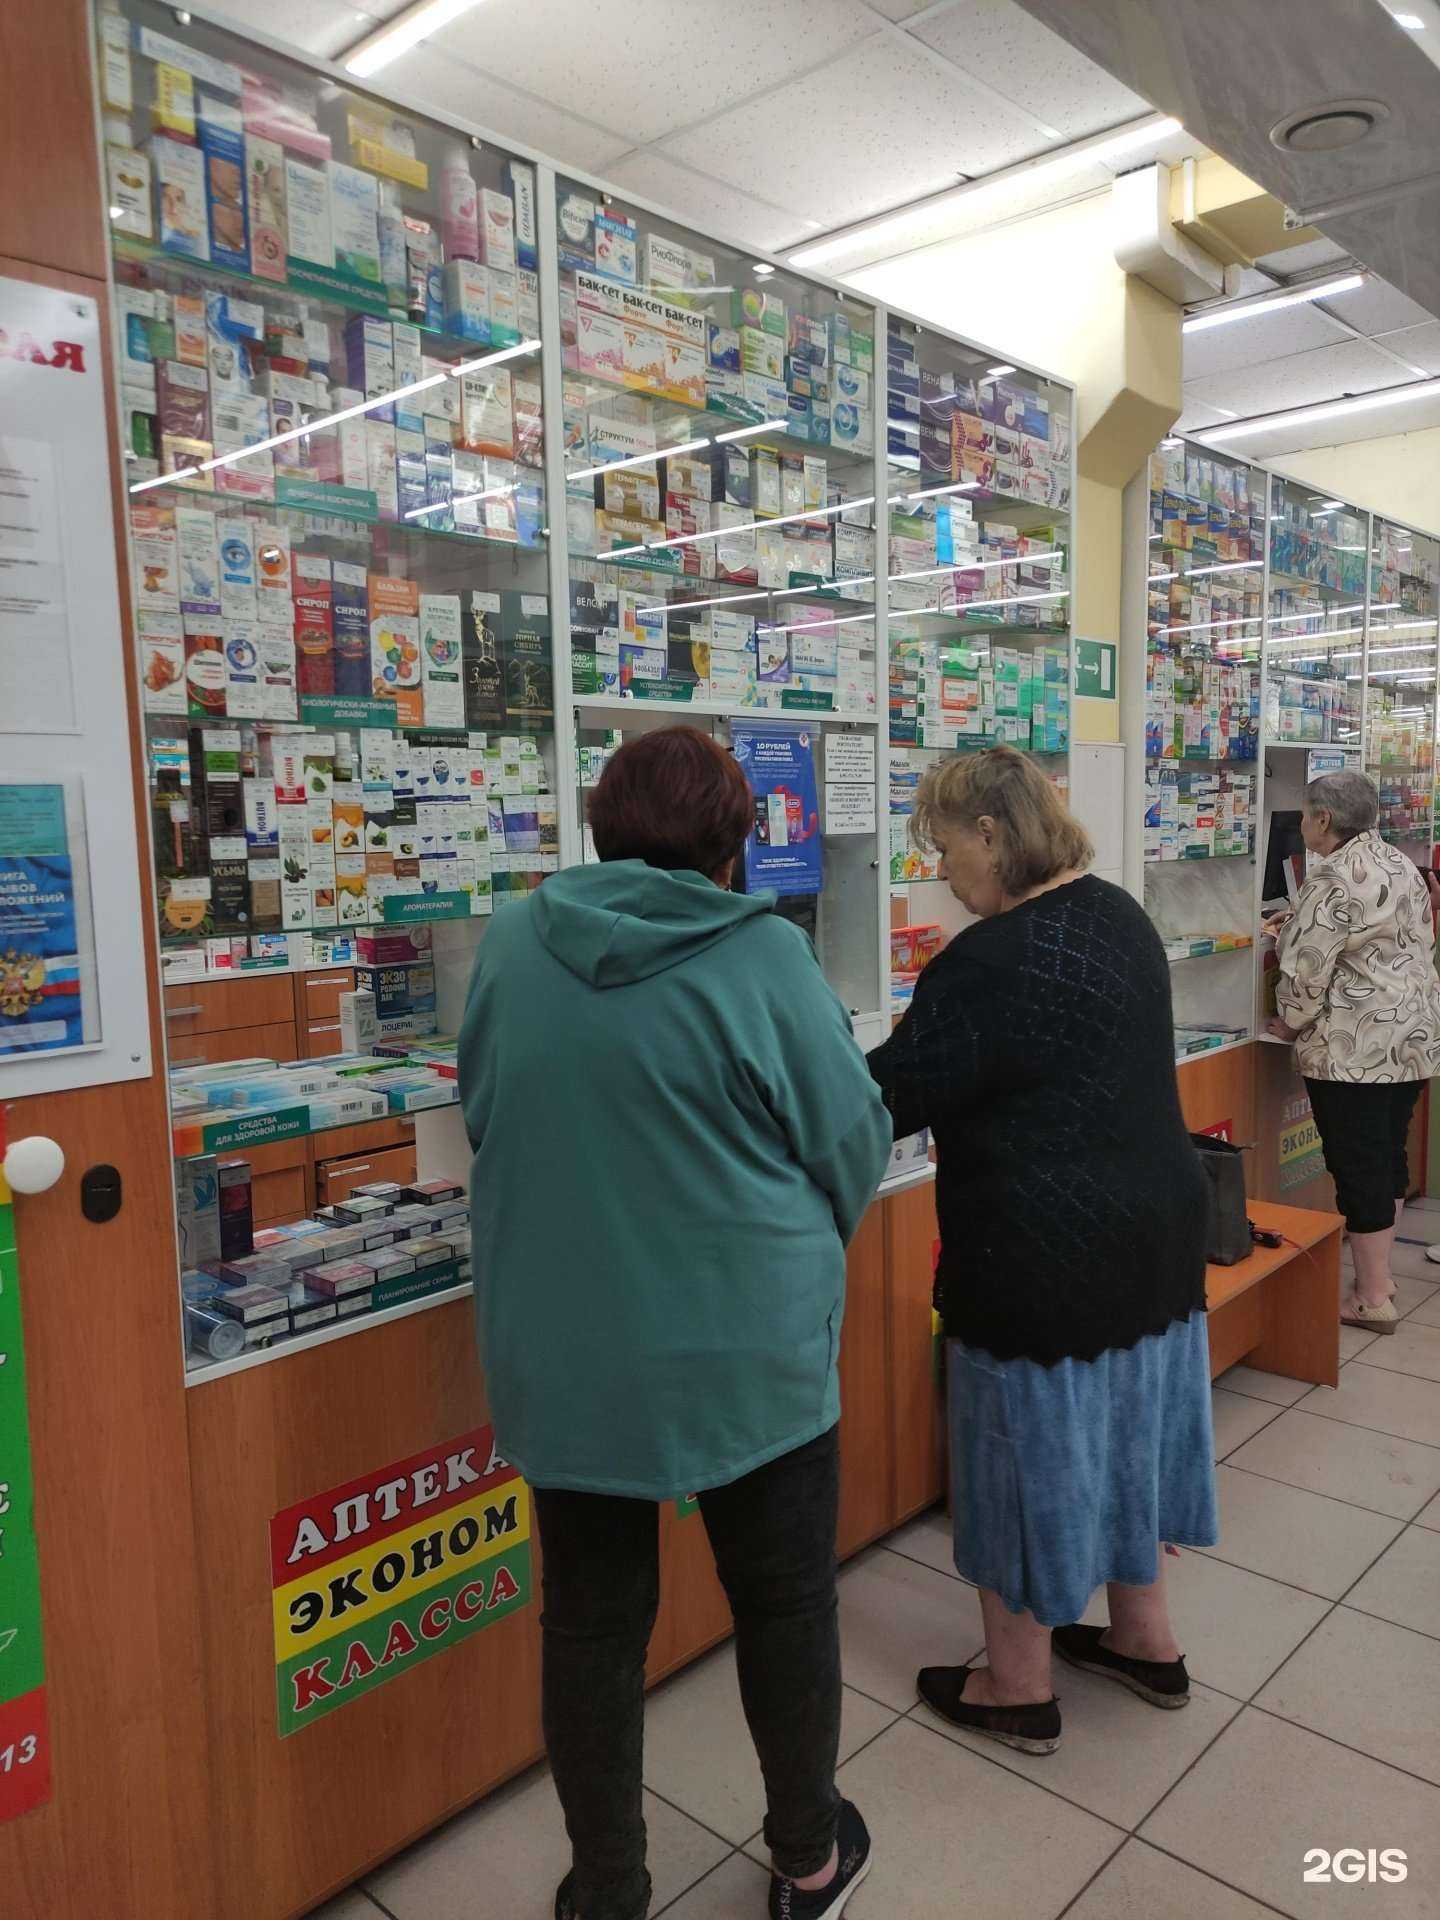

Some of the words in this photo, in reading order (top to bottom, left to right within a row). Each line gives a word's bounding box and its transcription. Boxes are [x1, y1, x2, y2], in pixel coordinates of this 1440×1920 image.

[296, 597, 330, 610] СИРОП
[335, 606, 368, 616] СИРОП
[765, 742, 791, 751] РУБЛЕЙ
[402, 900, 454, 912] АРОМАТЕРАПИЯ
[238, 1115, 278, 1131] СРЕДСТВА
[215, 1133, 233, 1146] ДЛЯ
[234, 1125, 277, 1142] ЗДОРОВОЙ
[277, 1121, 301, 1133] КОЖИ
[286, 1439, 511, 1564] АПТЕКА
[288, 1495, 519, 1635] ЭКОНОМ
[292, 1565, 520, 1713] КЛАССА
